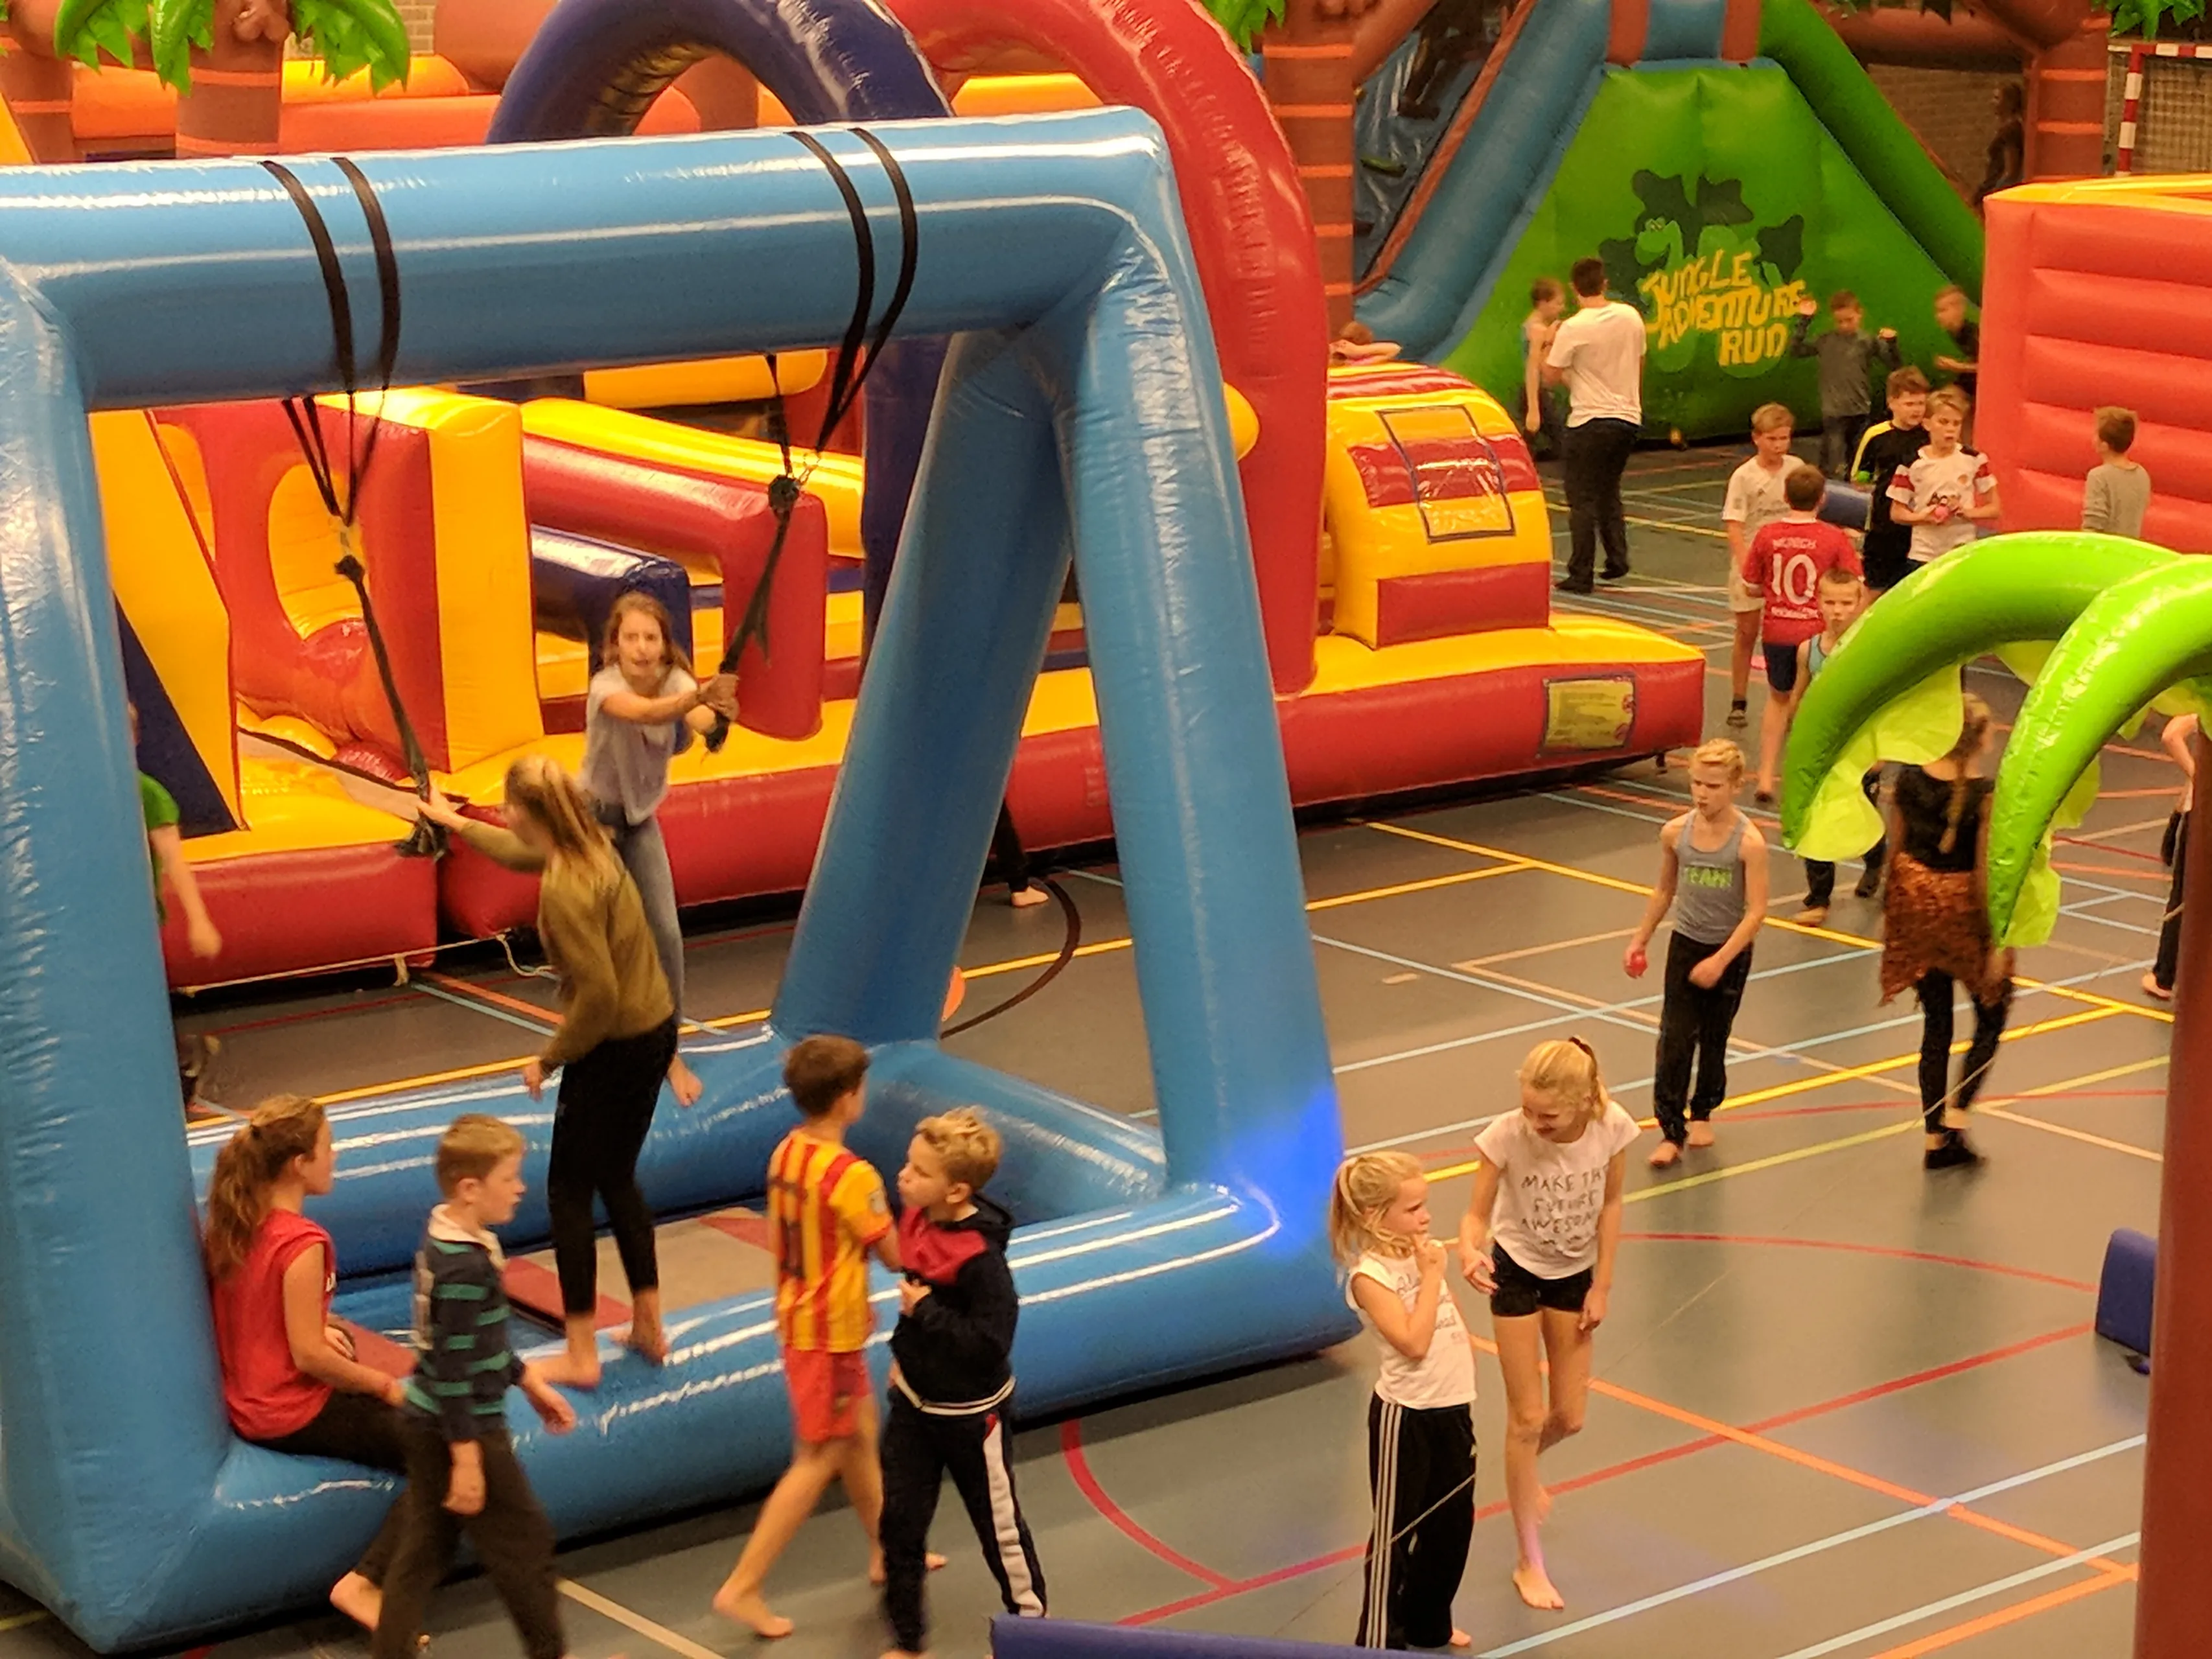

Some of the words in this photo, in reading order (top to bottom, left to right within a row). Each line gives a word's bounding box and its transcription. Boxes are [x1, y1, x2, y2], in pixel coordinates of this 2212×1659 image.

[1642, 249, 1752, 332] JUNGLE
[1658, 279, 1806, 350] ADVENTURE
[1718, 323, 1787, 366] RUN
[1771, 553, 1817, 605] 10
[1520, 1174, 1574, 1192] MAKE
